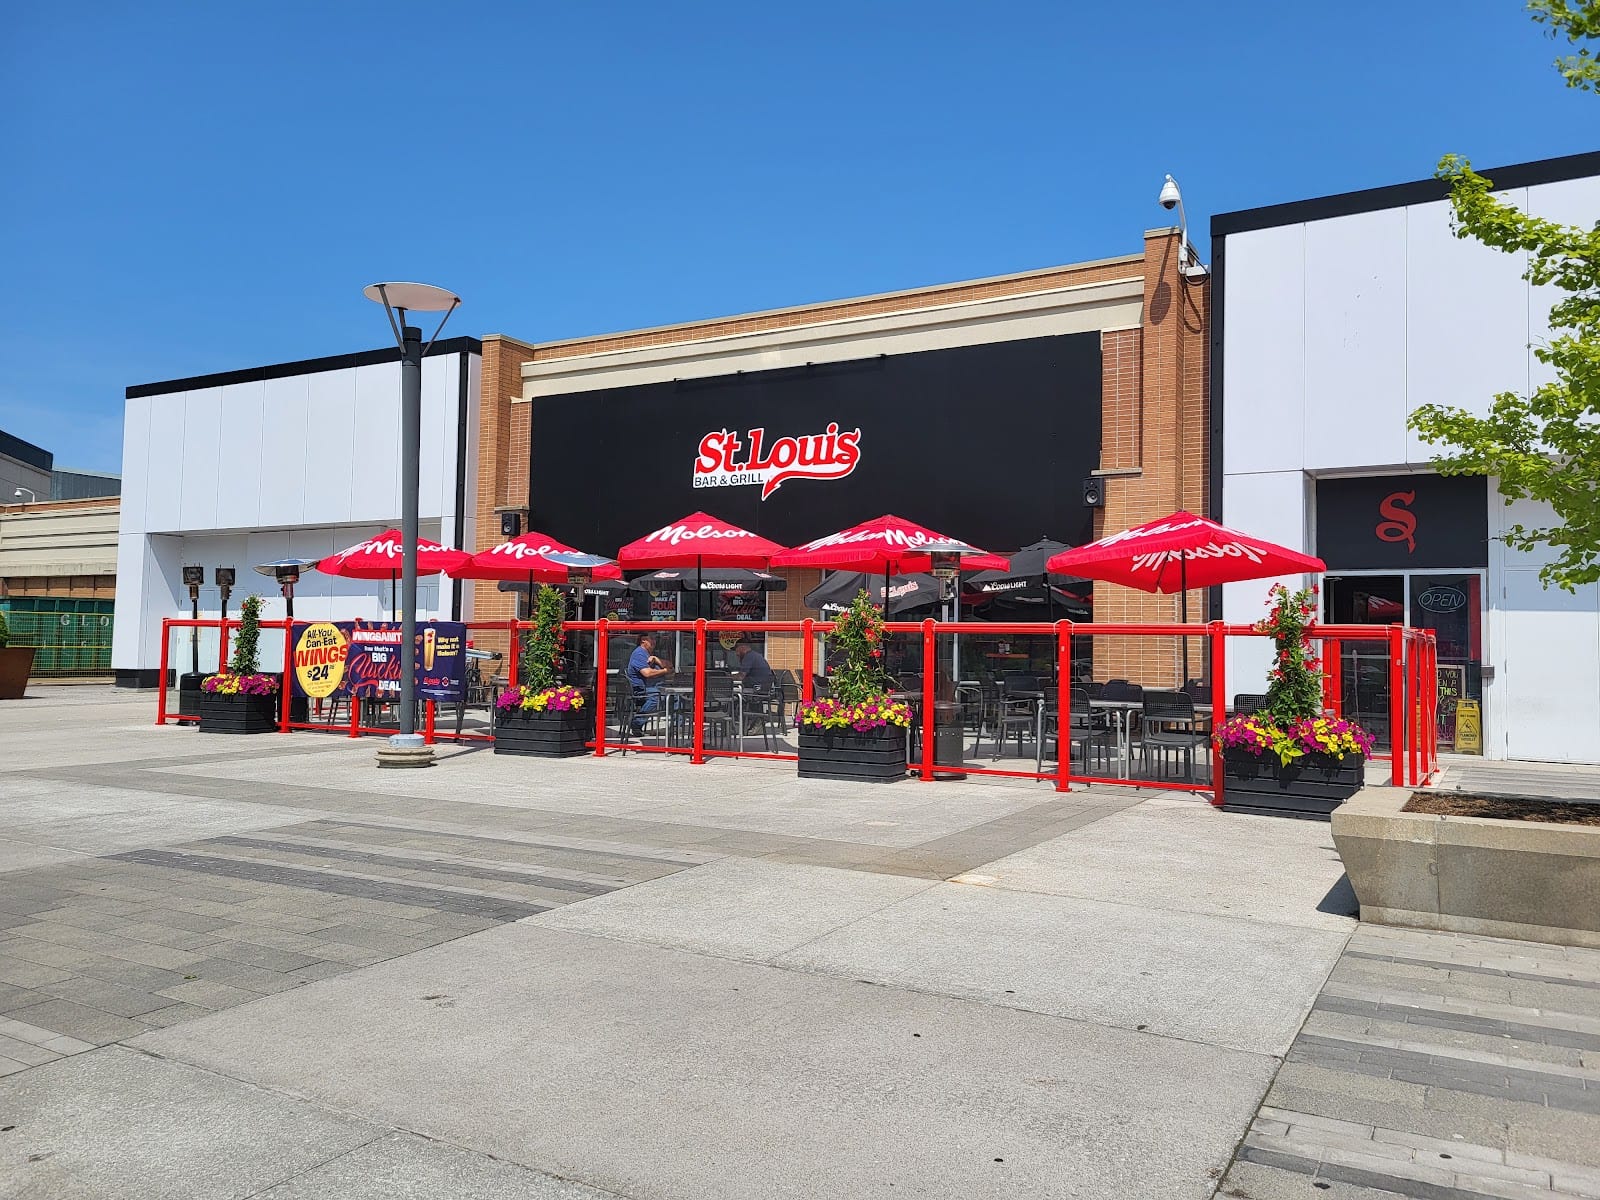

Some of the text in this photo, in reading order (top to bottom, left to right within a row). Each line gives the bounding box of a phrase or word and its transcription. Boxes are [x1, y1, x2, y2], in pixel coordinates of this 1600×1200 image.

[694, 472, 763, 487] BAR & GRILL
[644, 524, 760, 546] Molson
[365, 539, 458, 559] Moson
[1011, 581, 1027, 589] LIGHT
[650, 602, 676, 610] POUR
[1420, 593, 1462, 607] OPEN
[306, 636, 337, 649] Can-Eat
[352, 631, 402, 643] WINGSANIT
[294, 644, 348, 668] WINGS
[371, 652, 387, 663] BIG
[378, 680, 402, 692] DEAL
[1439, 687, 1458, 697] THIS
